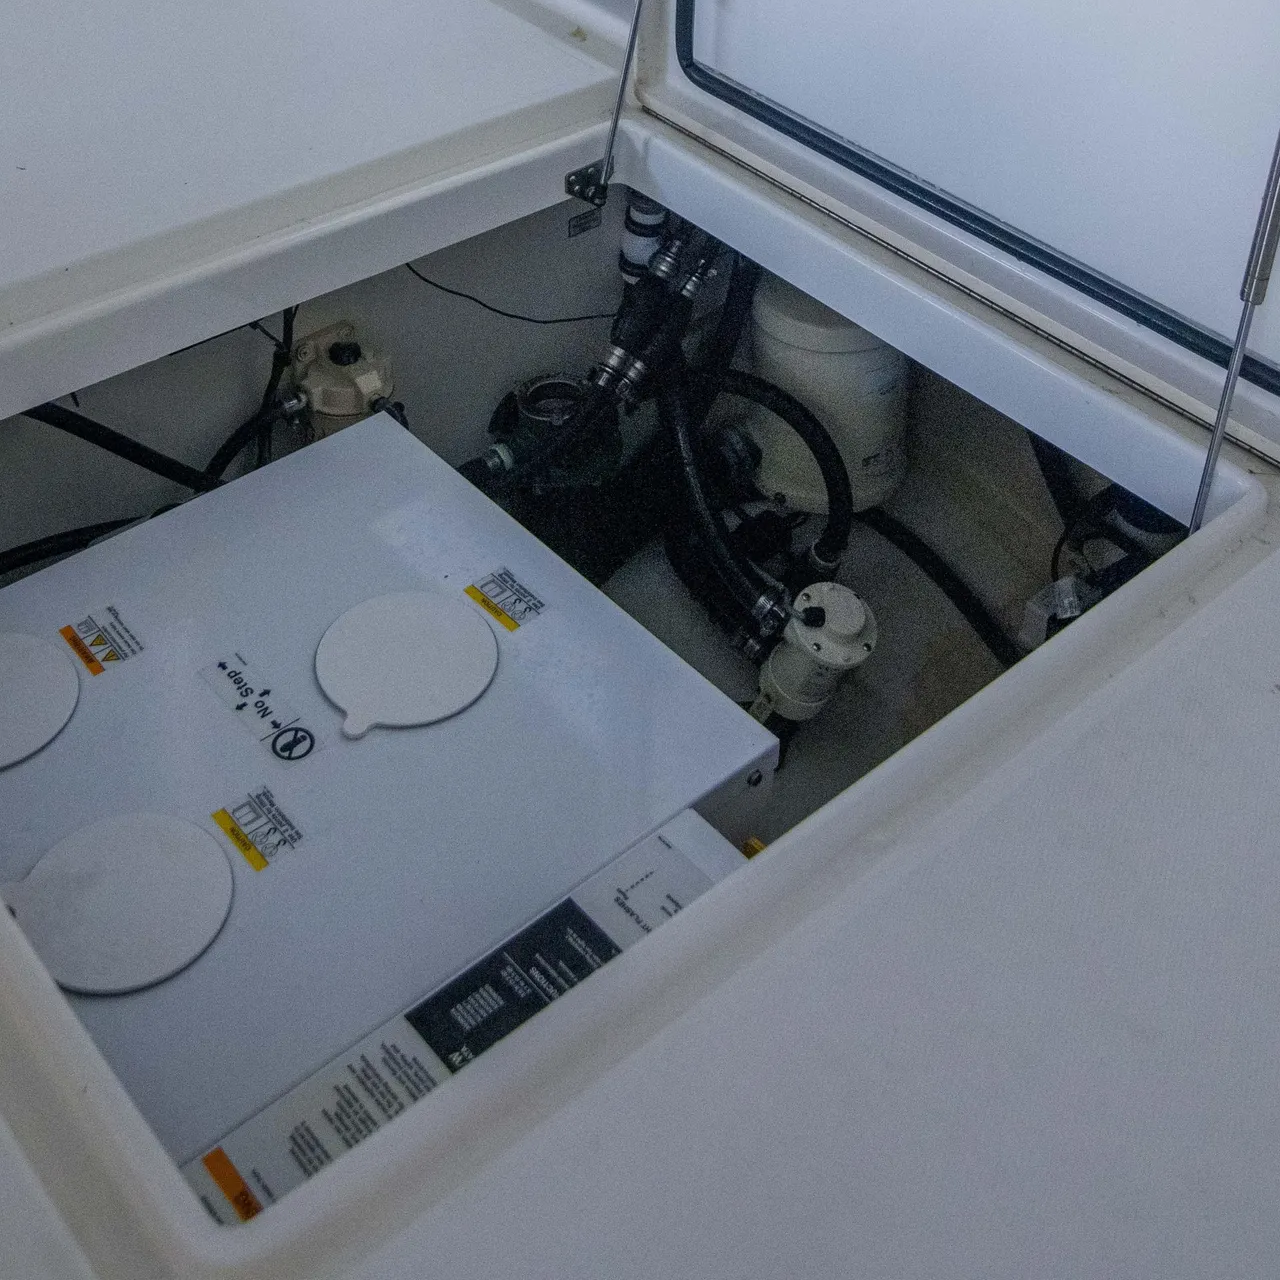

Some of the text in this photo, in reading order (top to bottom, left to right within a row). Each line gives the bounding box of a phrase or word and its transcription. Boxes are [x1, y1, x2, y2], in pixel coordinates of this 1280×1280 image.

[480, 597, 502, 617] CAUTION
[226, 667, 254, 699] Step
[251, 697, 273, 719] No
[228, 825, 251, 851] CAUTION
